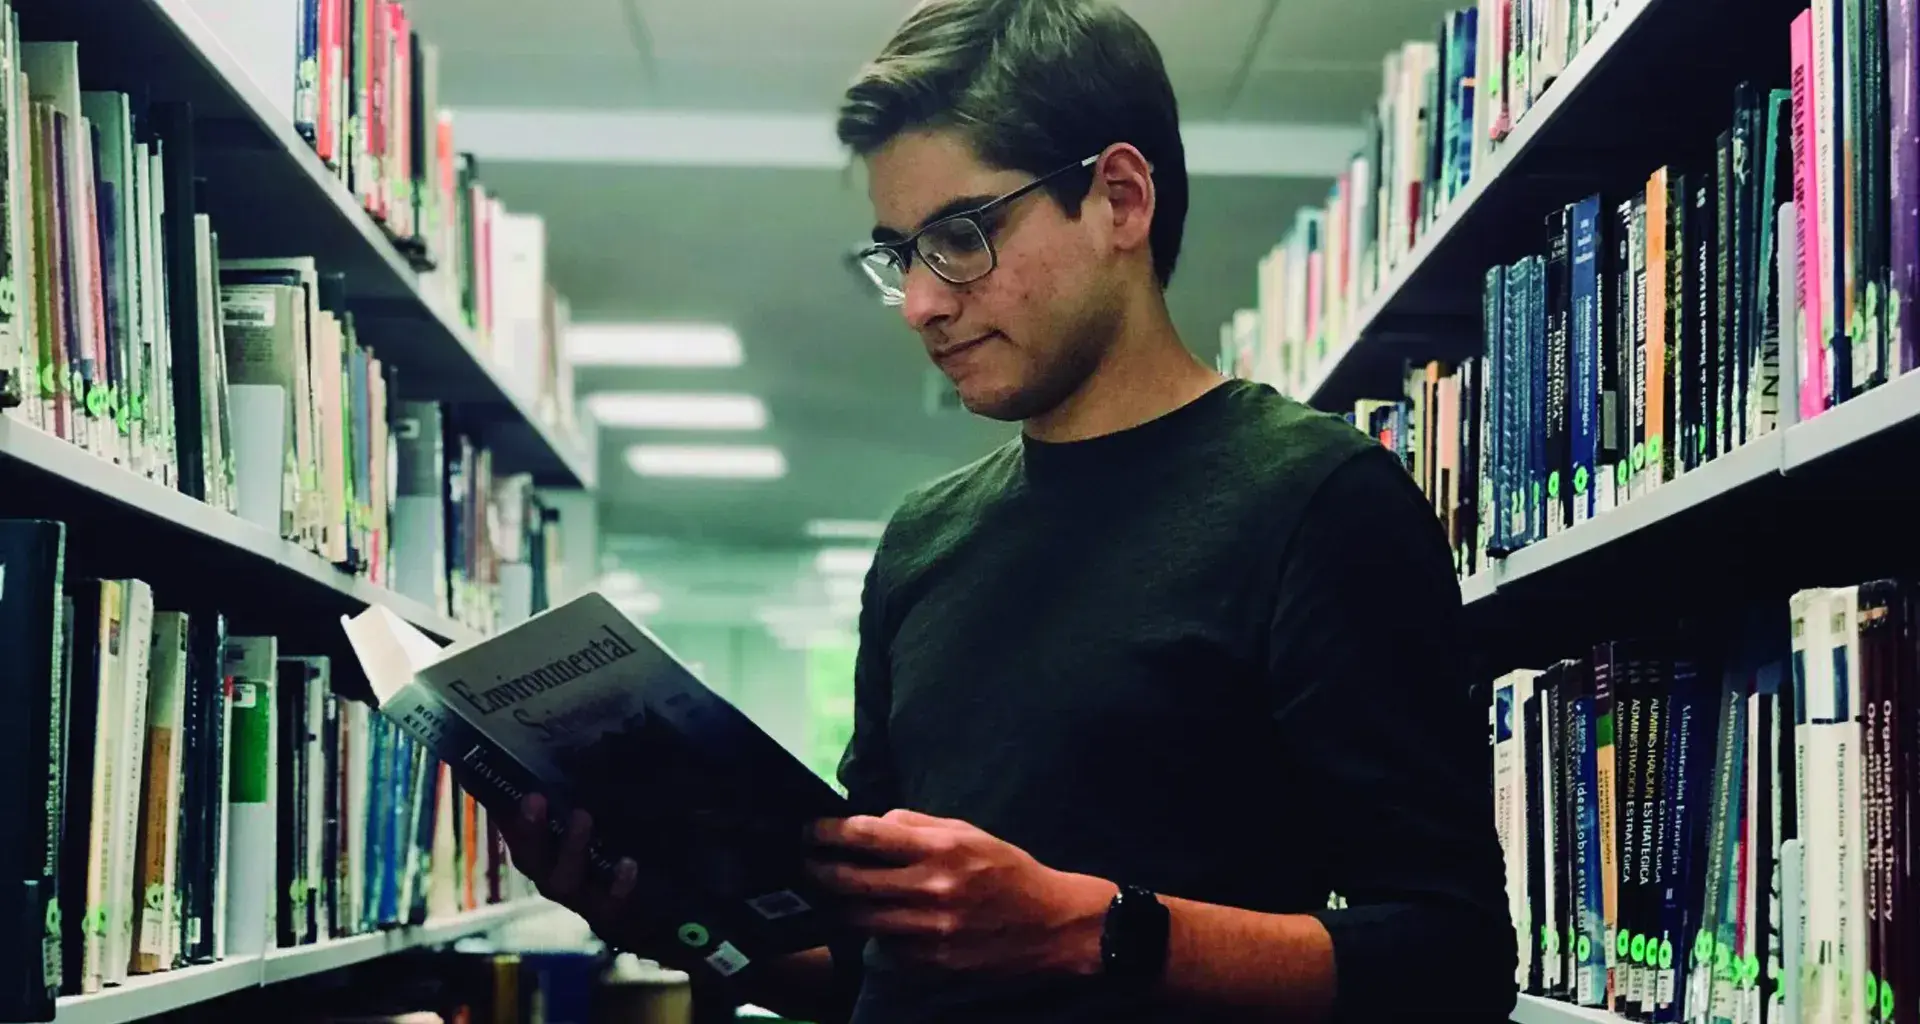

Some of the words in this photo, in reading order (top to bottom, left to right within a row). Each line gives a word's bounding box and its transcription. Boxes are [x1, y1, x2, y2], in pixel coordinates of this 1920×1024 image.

[1635, 272, 1648, 341] Dirección
[1634, 342, 1647, 427] Estratégica
[448, 625, 638, 716] Environmental
[1676, 703, 1693, 801] Administración
[1719, 690, 1739, 817] Administración
[1866, 702, 1878, 840] Organization
[1881, 699, 1894, 839] Organization
[1577, 782, 1588, 817] Ideas
[1577, 826, 1588, 865] sobre
[1866, 846, 1878, 921] Theory
[1883, 845, 1895, 923] Theory
